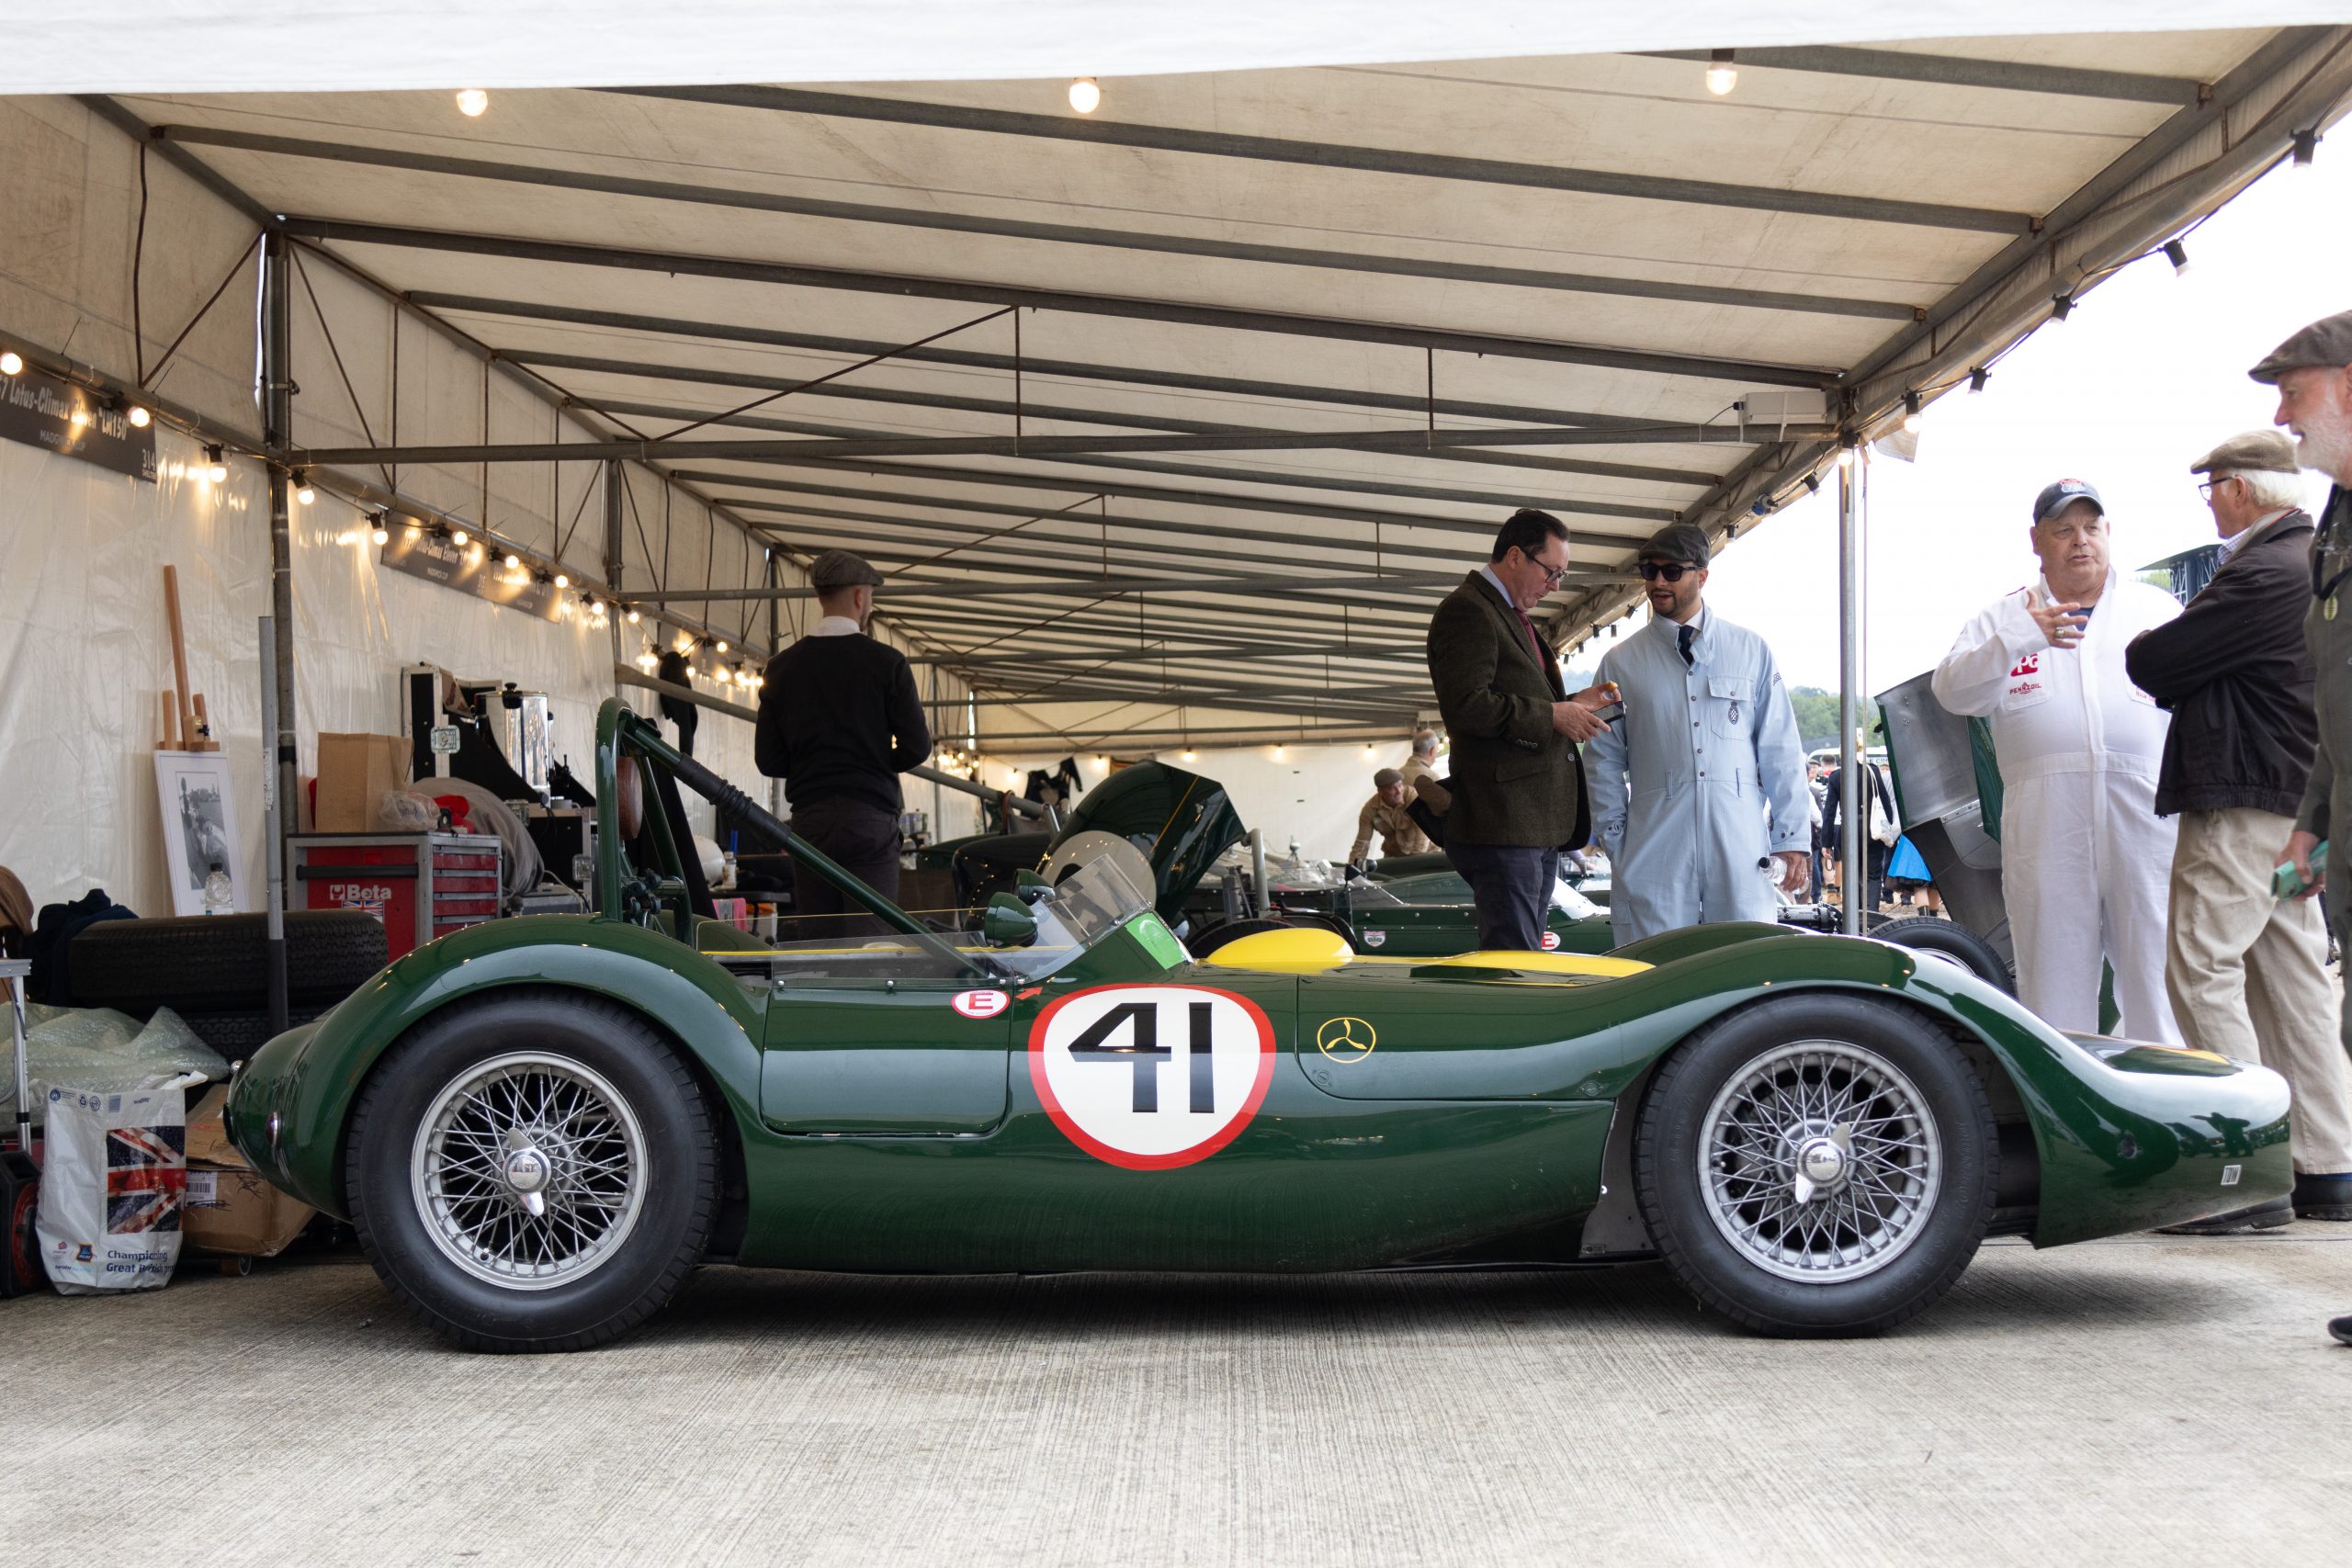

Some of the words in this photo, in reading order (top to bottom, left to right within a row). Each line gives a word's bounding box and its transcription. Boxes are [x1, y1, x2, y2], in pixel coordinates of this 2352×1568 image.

[9, 378, 70, 422] Lotus-Climax
[142, 448, 156, 471] 314
[2009, 682, 2041, 694] PENNZOIL
[347, 884, 392, 899] Beta
[1542, 933, 1555, 948] E
[968, 993, 994, 1010] E
[1067, 1002, 1215, 1113] 41
[107, 1249, 168, 1263] Championing
[107, 1262, 135, 1273] Great
